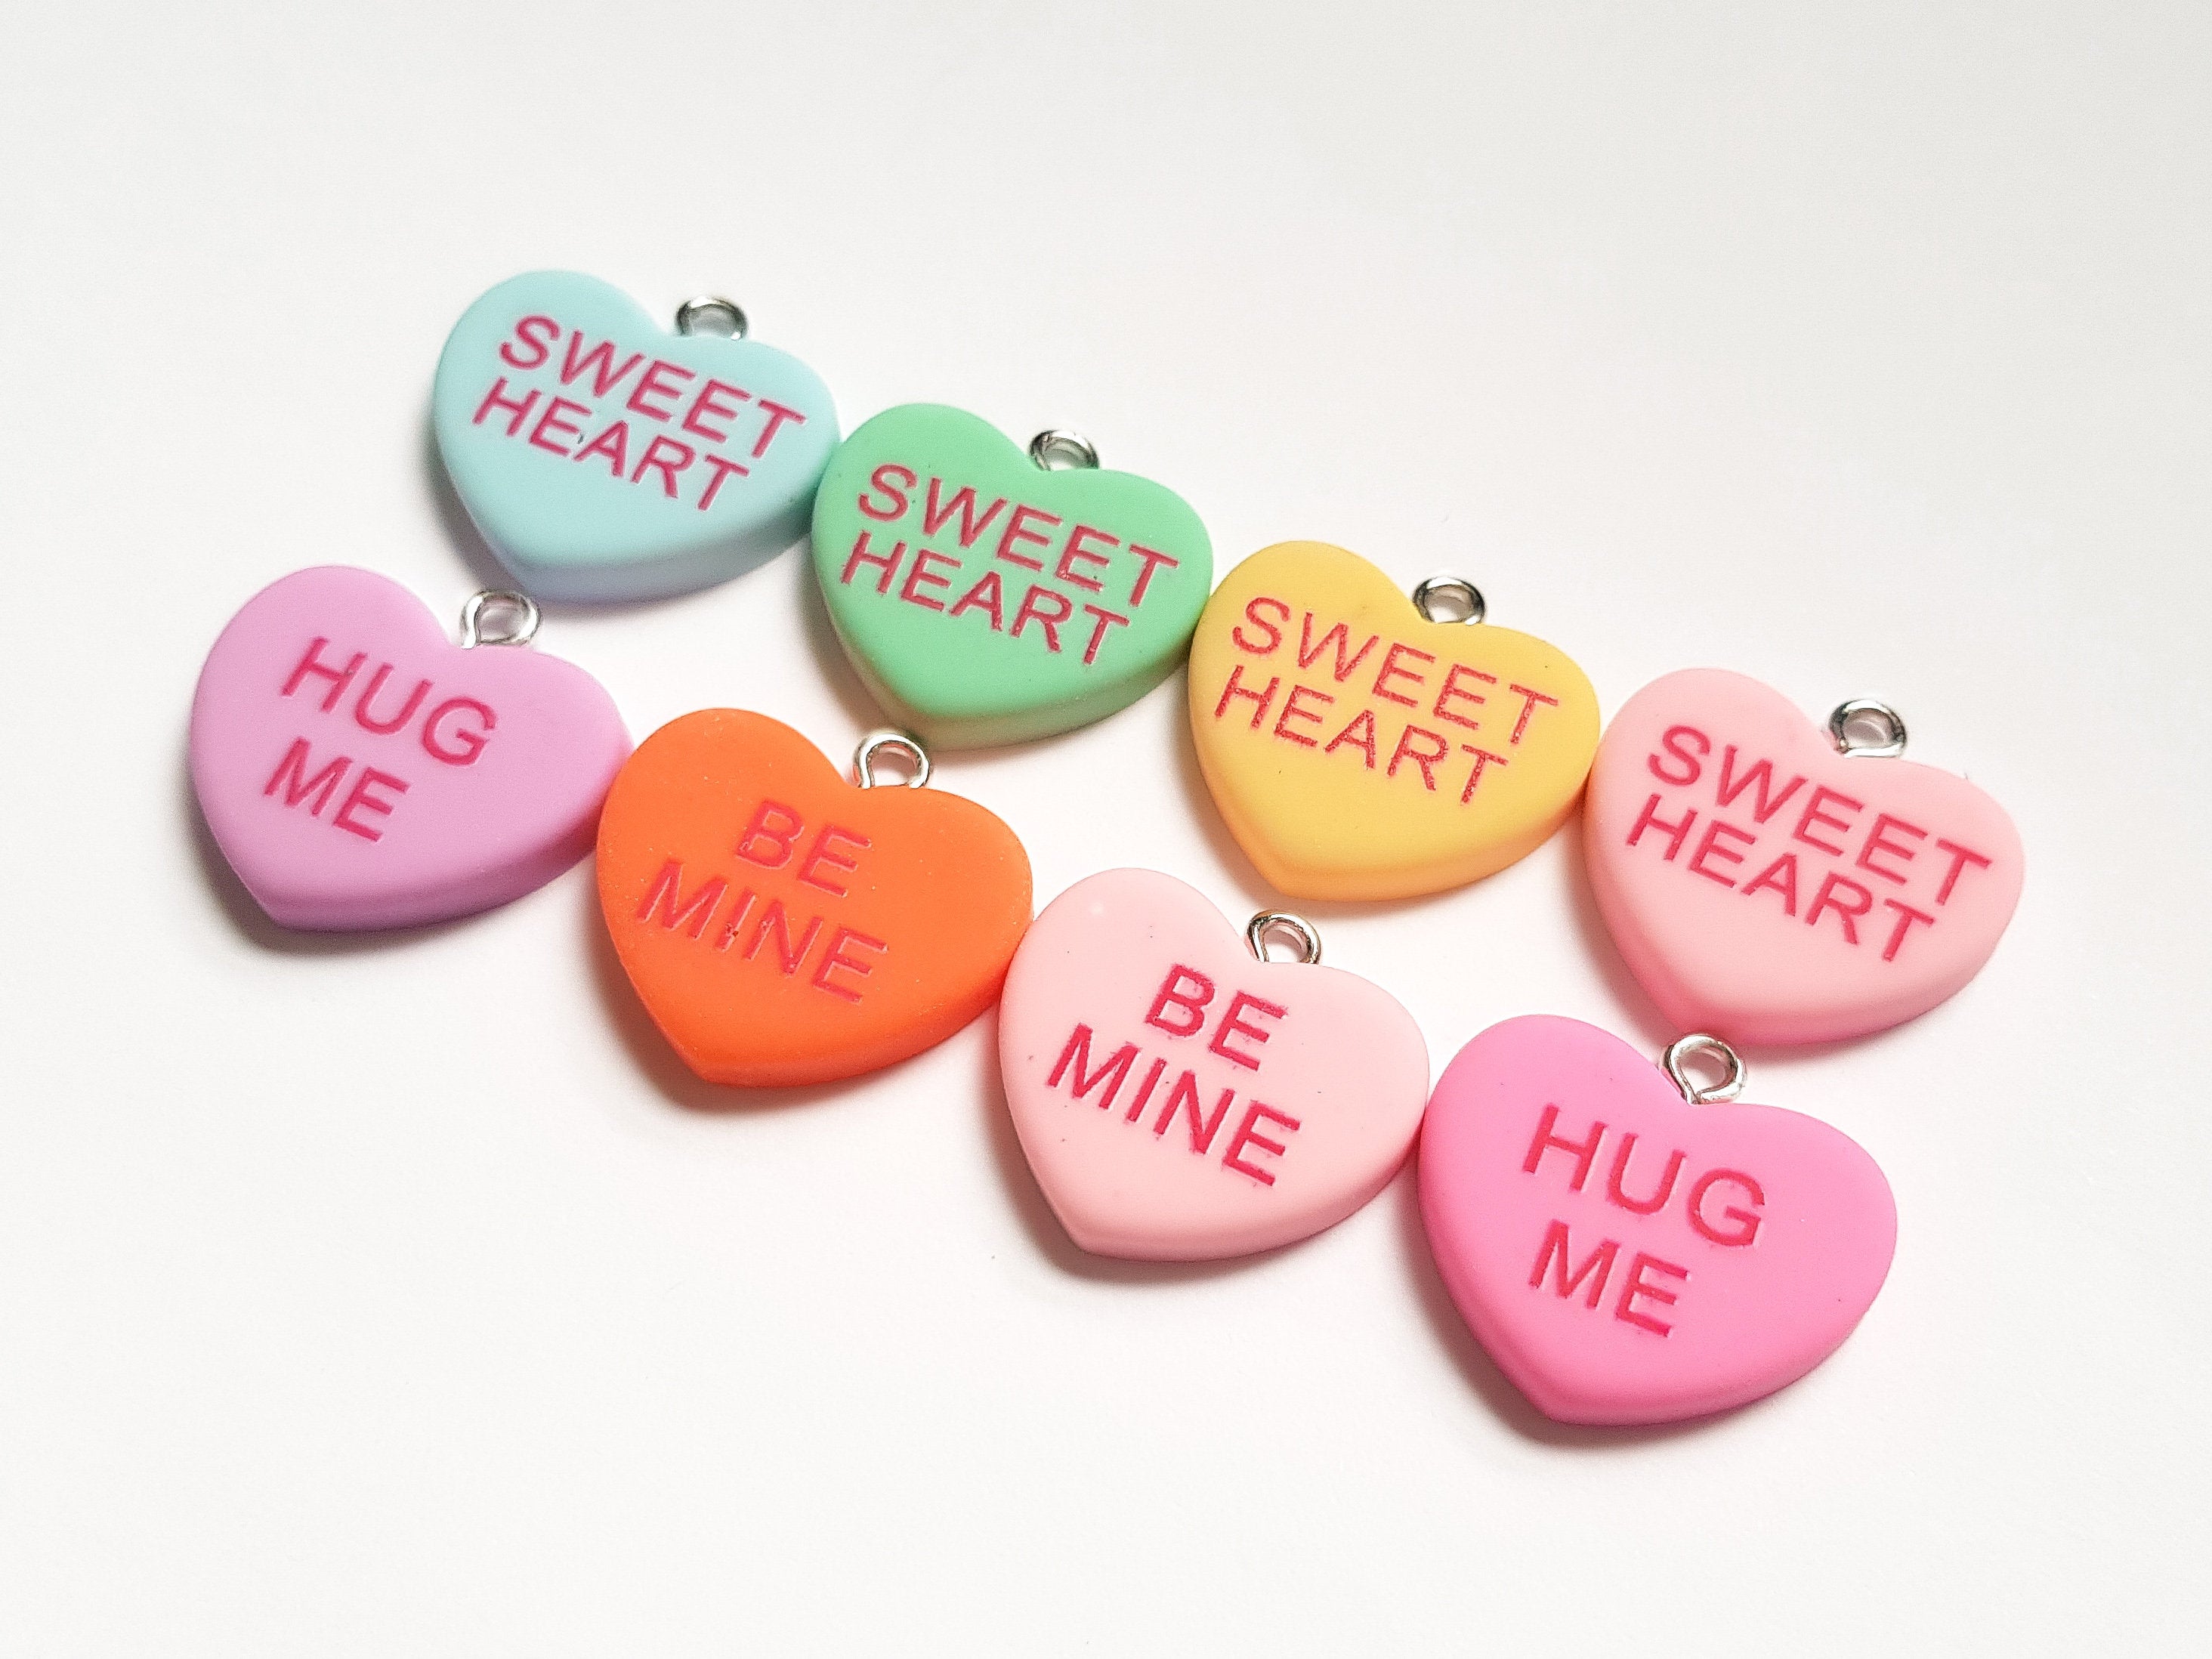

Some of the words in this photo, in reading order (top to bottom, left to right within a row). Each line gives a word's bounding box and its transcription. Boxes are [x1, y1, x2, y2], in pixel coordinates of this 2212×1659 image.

[473, 377, 749, 510] HEART
[500, 315, 805, 456] SWEET
[841, 530, 1129, 665] HEART
[858, 463, 1179, 607] SWEET
[282, 636, 498, 767] HUG
[1214, 665, 1508, 805] HEART
[1231, 596, 1559, 745] SWEET
[264, 737, 410, 842] ME
[737, 799, 873, 897] BE
[1648, 724, 1992, 904] SWEET
[637, 857, 888, 1004] MINE
[1627, 793, 1936, 962] HEART
[1145, 964, 1290, 1072] BE
[1047, 1023, 1301, 1188] MINE
[1523, 1102, 1766, 1248] HUG
[1528, 1219, 1690, 1337] ME
